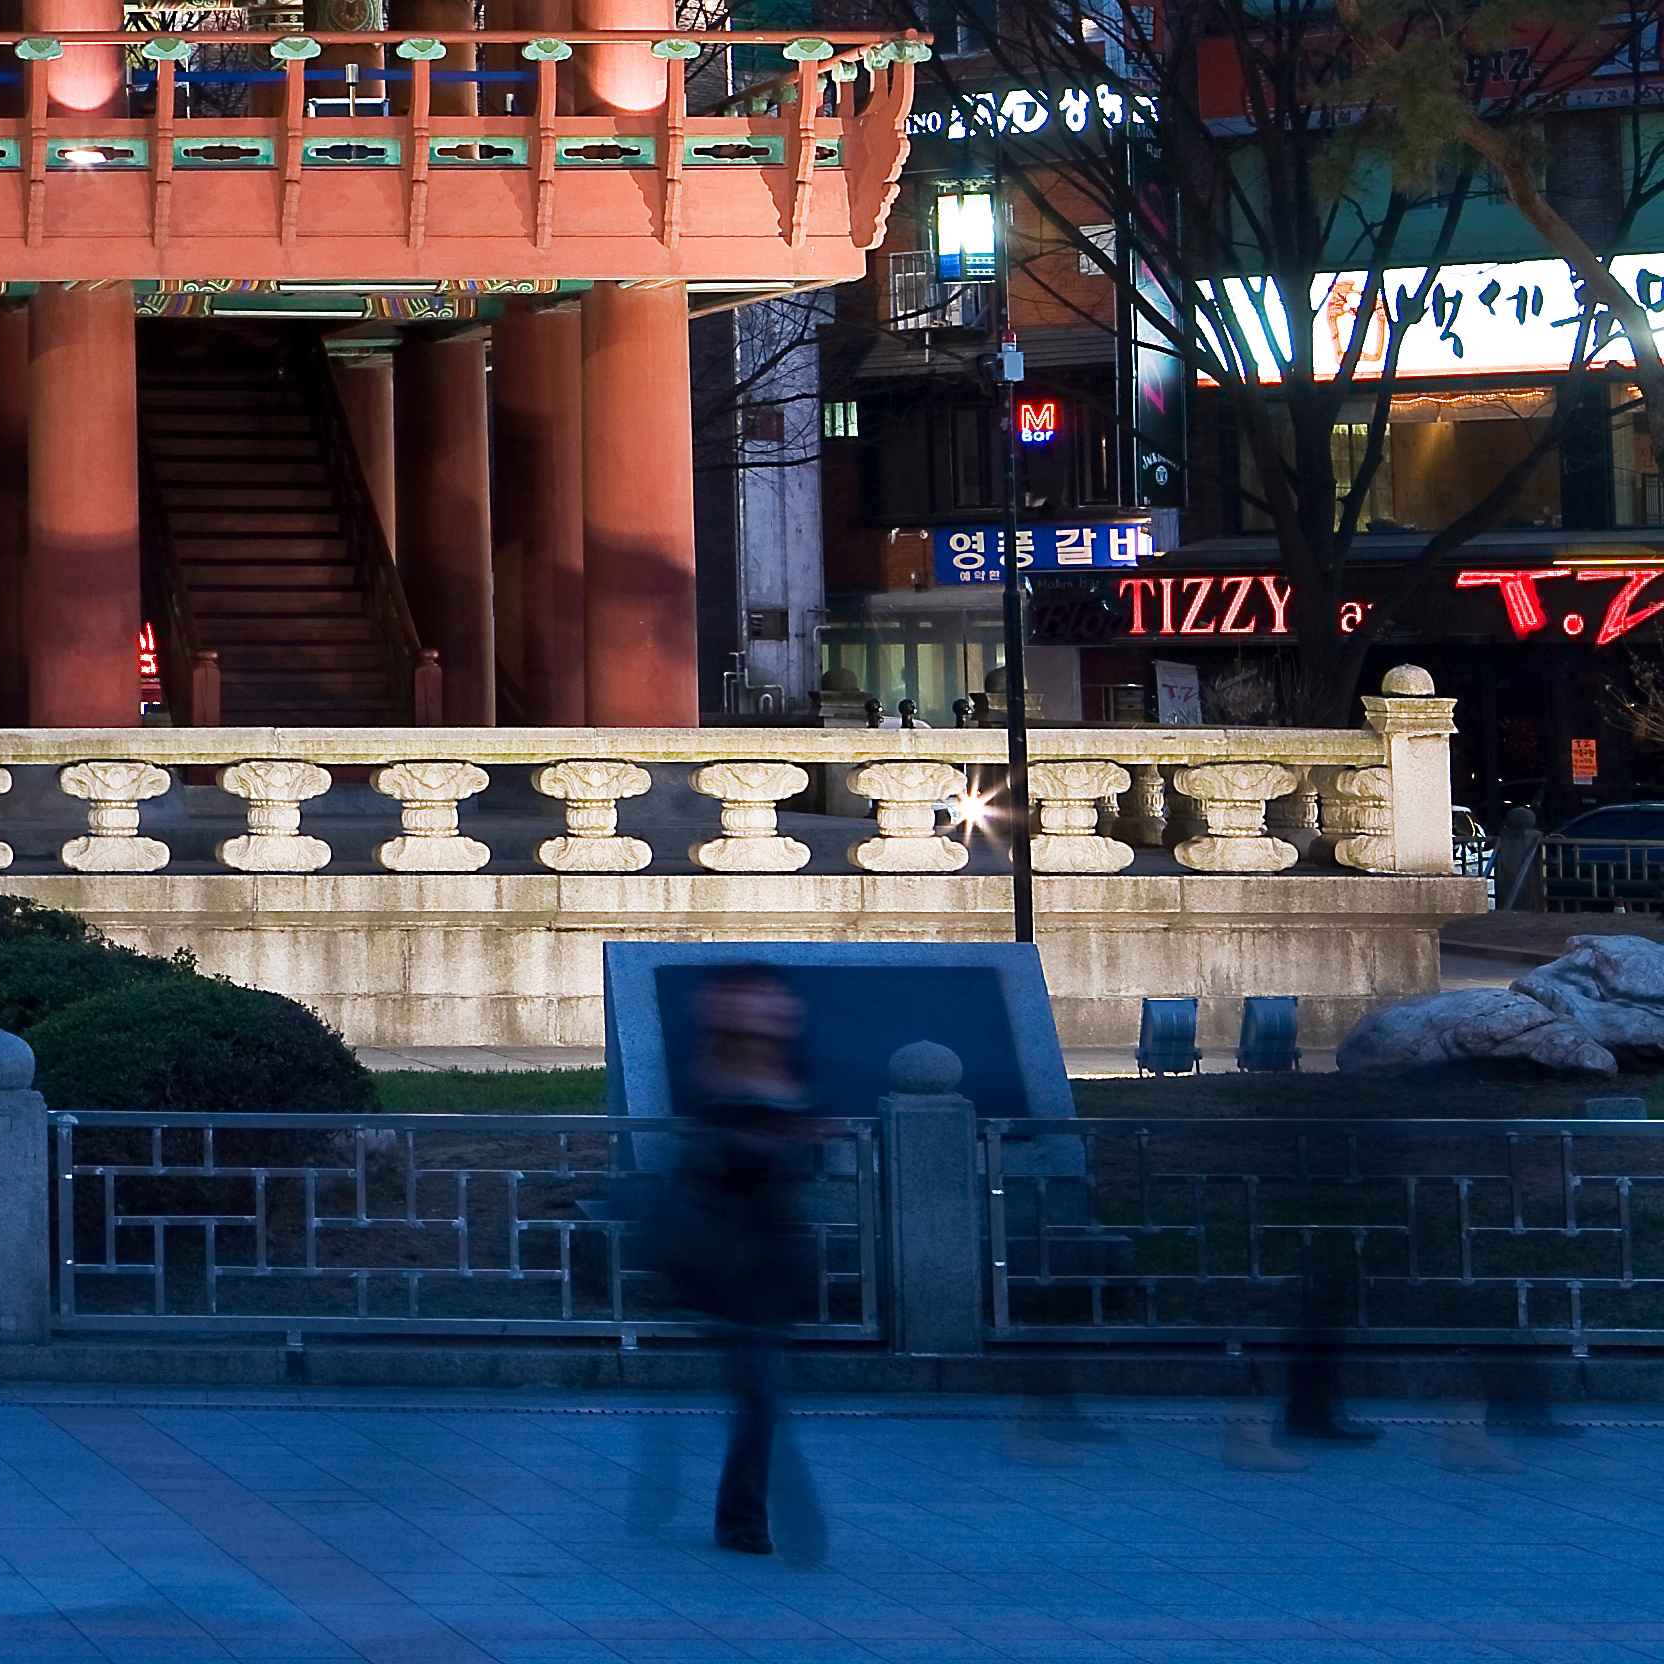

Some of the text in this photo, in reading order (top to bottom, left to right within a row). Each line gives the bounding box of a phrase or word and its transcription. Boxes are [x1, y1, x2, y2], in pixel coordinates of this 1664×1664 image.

[1021, 403, 1055, 430] M
[1021, 429, 1054, 442] Bar
[1119, 575, 1292, 634] TIZZY
